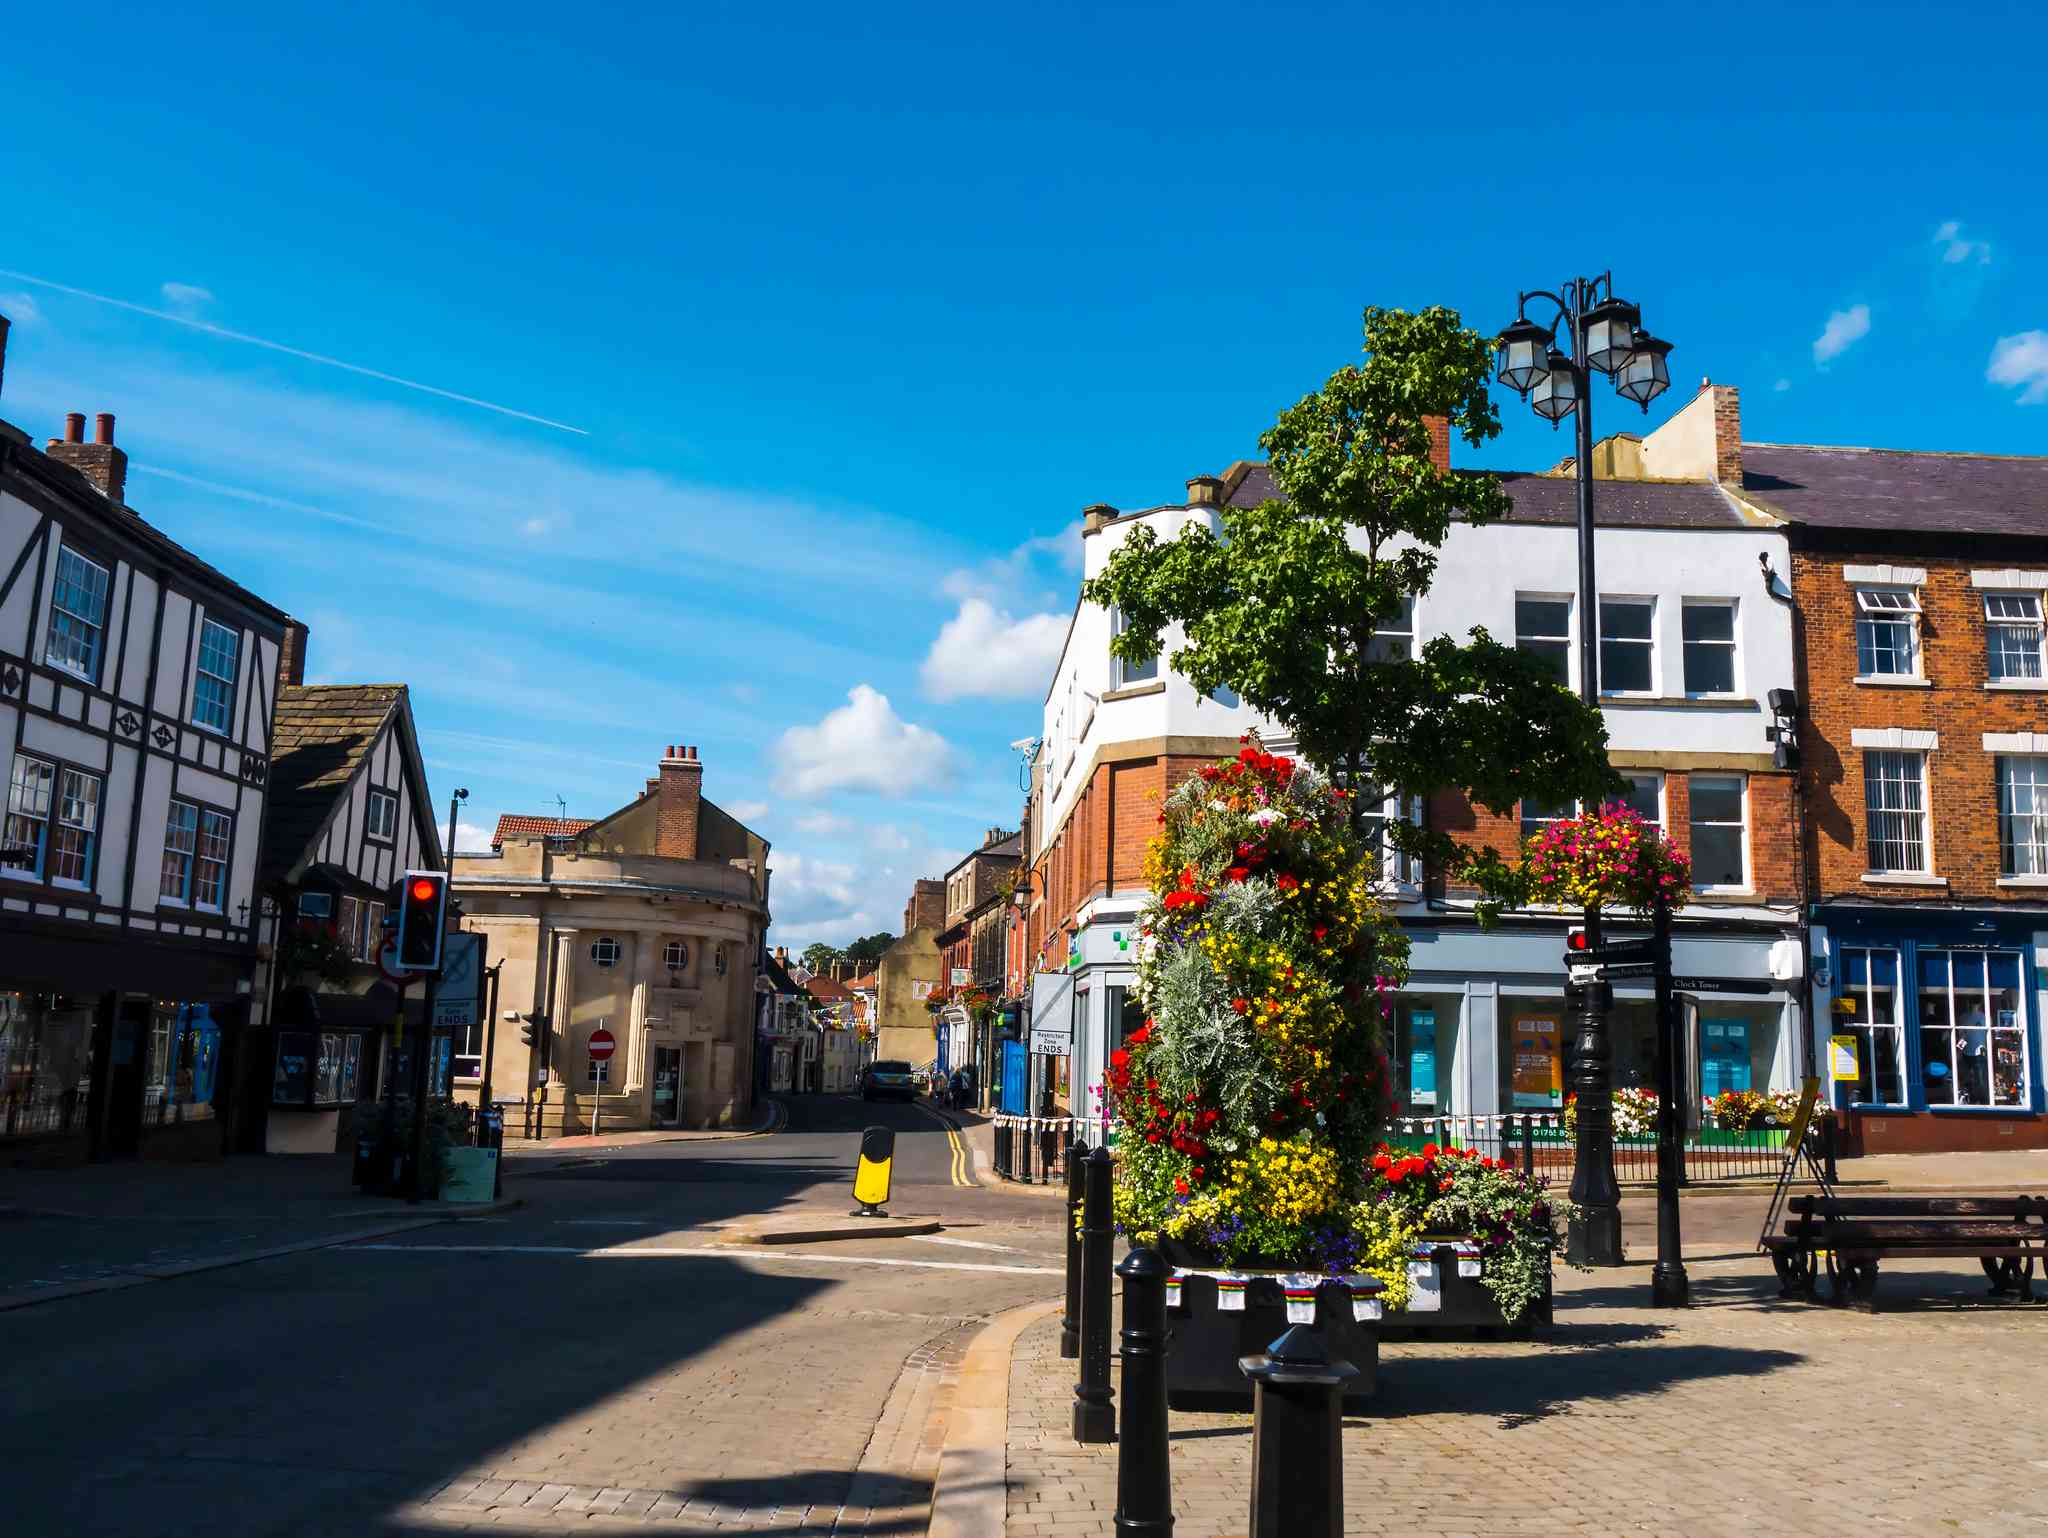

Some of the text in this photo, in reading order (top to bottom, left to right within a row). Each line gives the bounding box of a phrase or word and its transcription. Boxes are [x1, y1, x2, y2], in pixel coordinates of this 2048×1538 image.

[1674, 979, 1719, 989] Clock Tower
[438, 1015, 468, 1025] ENDS
[1038, 1044, 1062, 1053] ENDS
